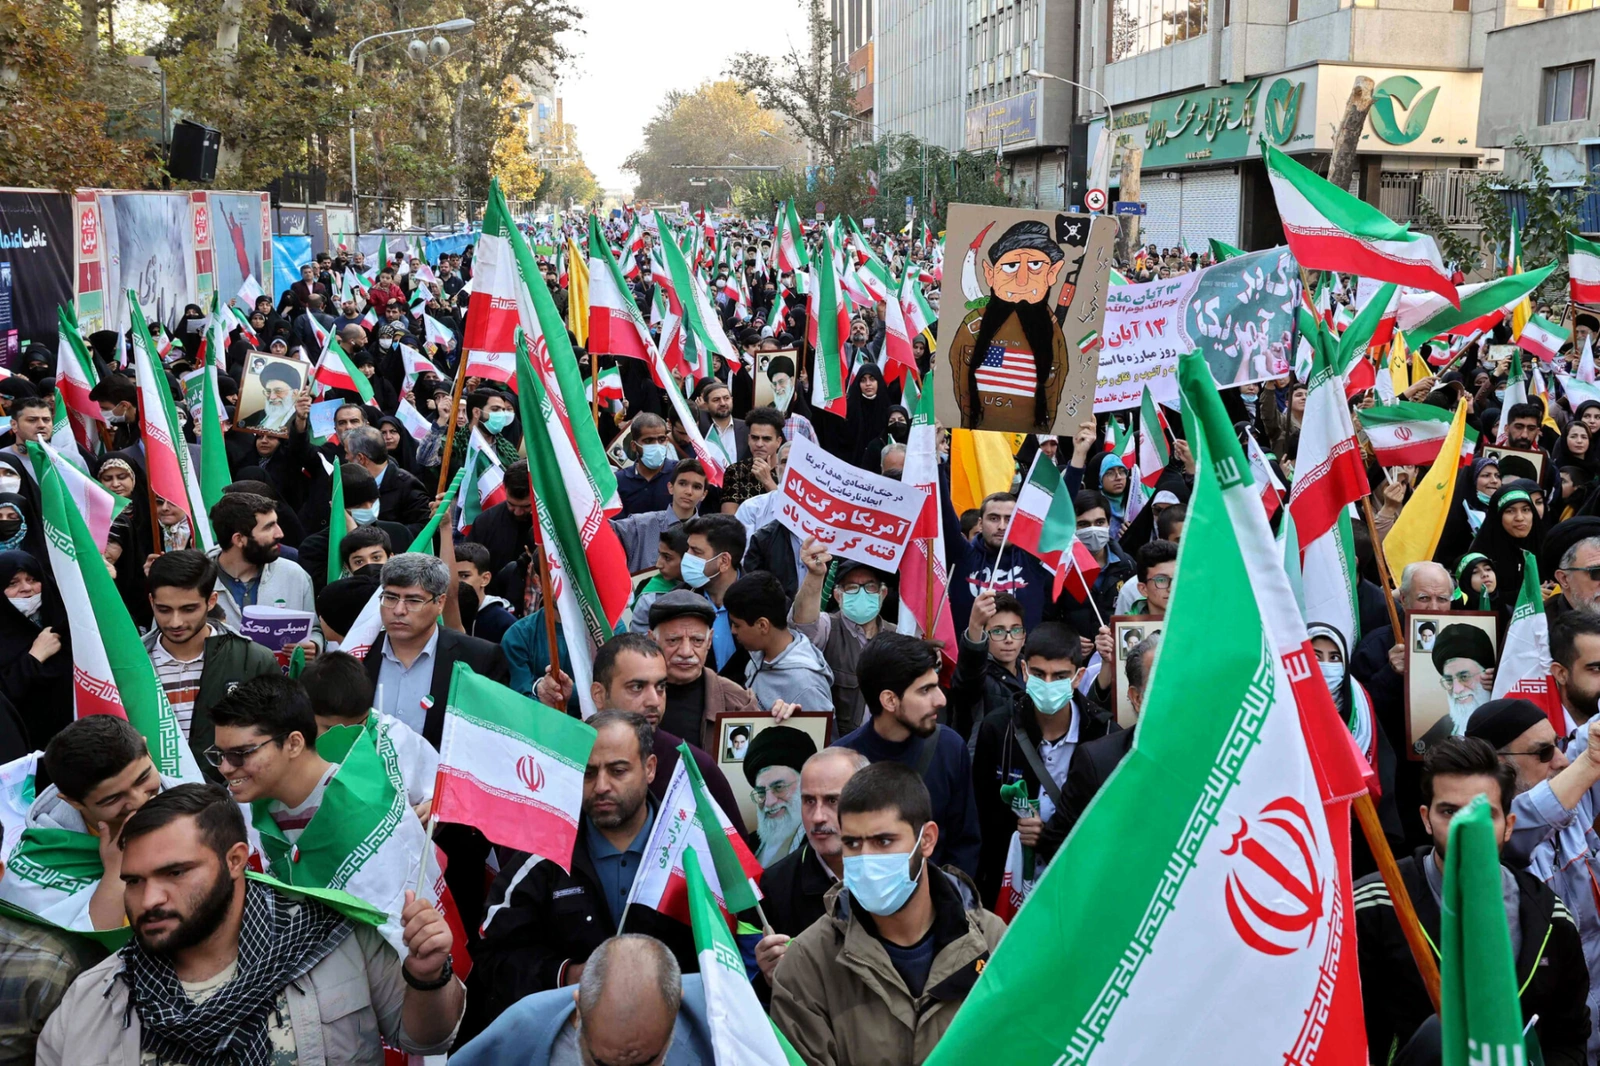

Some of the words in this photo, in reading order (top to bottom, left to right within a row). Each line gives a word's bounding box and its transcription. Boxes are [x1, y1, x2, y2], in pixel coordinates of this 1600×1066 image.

[0, 227, 22, 249] اعتما
[1108, 292, 1131, 302] ماه
[1108, 321, 1141, 347] آبان
[1145, 317, 1165, 337] ۱۳
[1098, 355, 1117, 366] است
[1117, 353, 1125, 365] با
[1126, 350, 1157, 364] مبارزه
[1159, 348, 1176, 359] روز
[984, 396, 1013, 408] USA
[805, 452, 826, 471] آمریکا
[825, 466, 842, 480] هدف
[815, 475, 830, 488] است
[841, 477, 875, 493] اقتصادی
[788, 477, 806, 502] باد
[874, 486, 893, 500] جنگ
[861, 495, 882, 506] ایجاد
[893, 494, 904, 502] در
[805, 492, 847, 523] مرگت
[783, 503, 799, 527] باد
[850, 509, 909, 537] آمریکا
[801, 519, 836, 544] ننگت
[864, 543, 896, 561] فتنه
[273, 622, 307, 636] سیلی
